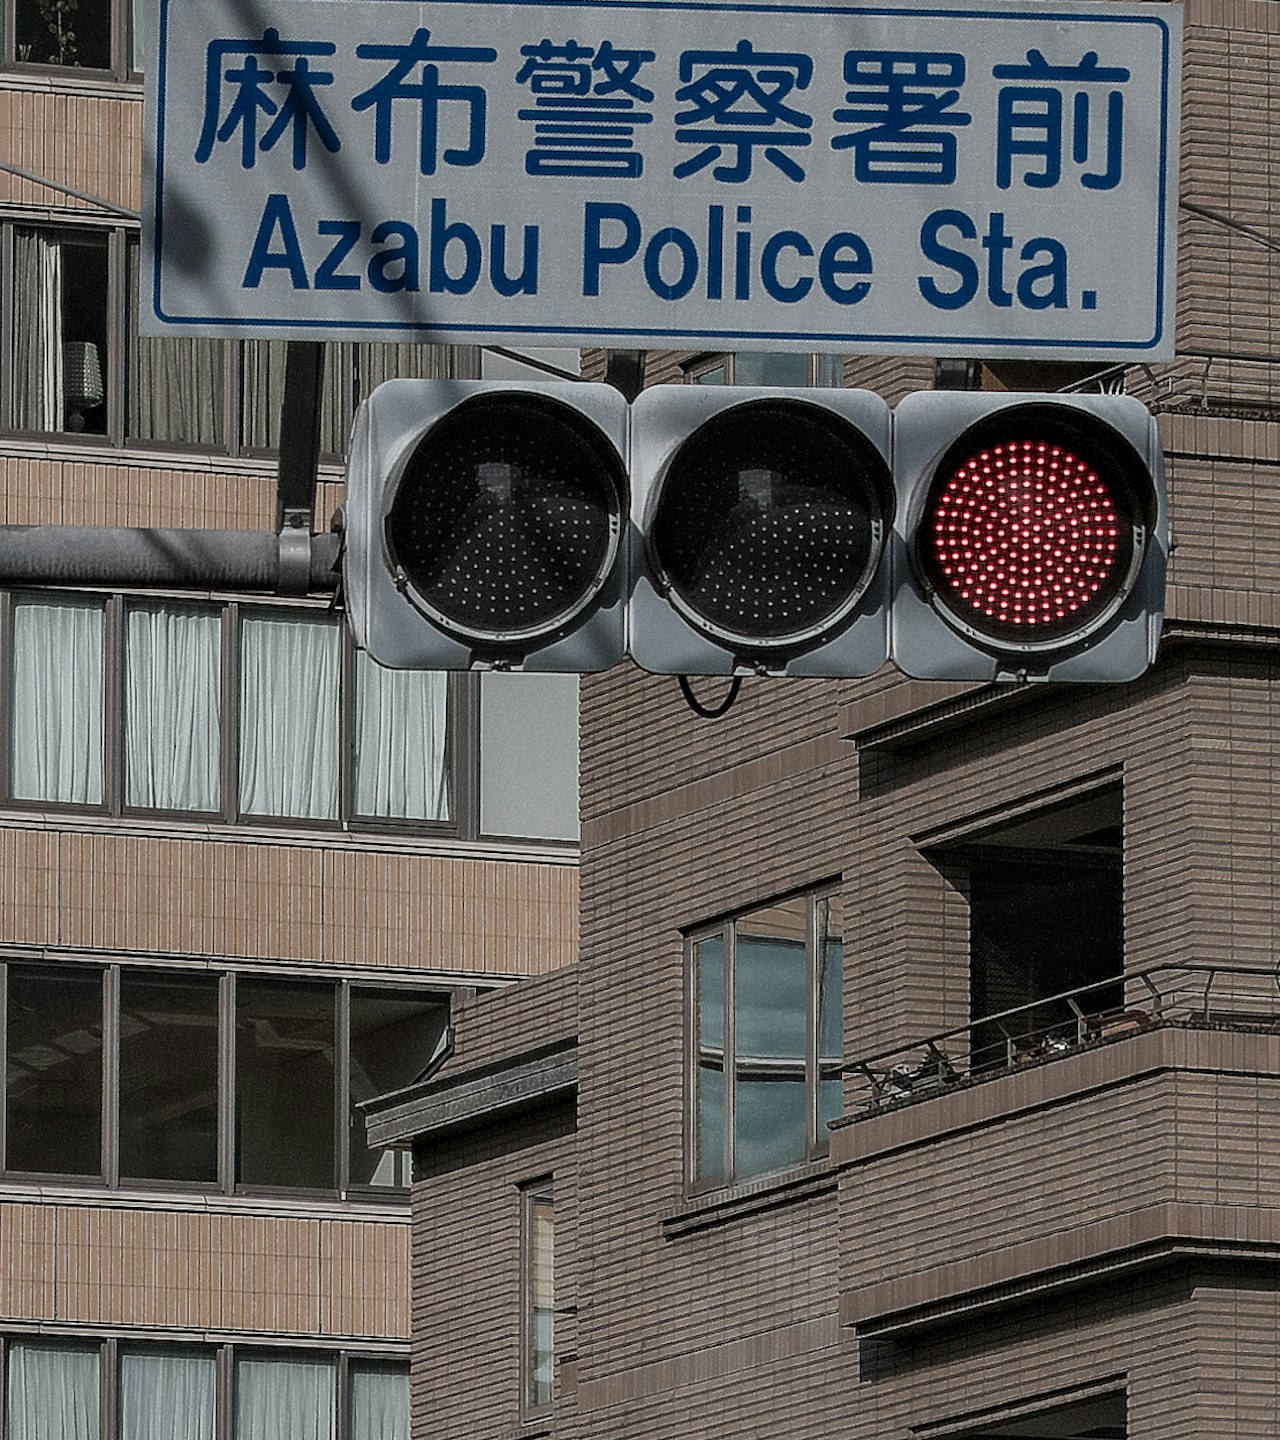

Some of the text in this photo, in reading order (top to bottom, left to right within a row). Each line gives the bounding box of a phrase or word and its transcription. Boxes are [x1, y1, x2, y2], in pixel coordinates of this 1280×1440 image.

[194, 26, 1130, 190] 麻布警察署前
[243, 193, 1099, 311] Azabu Police Sta.
